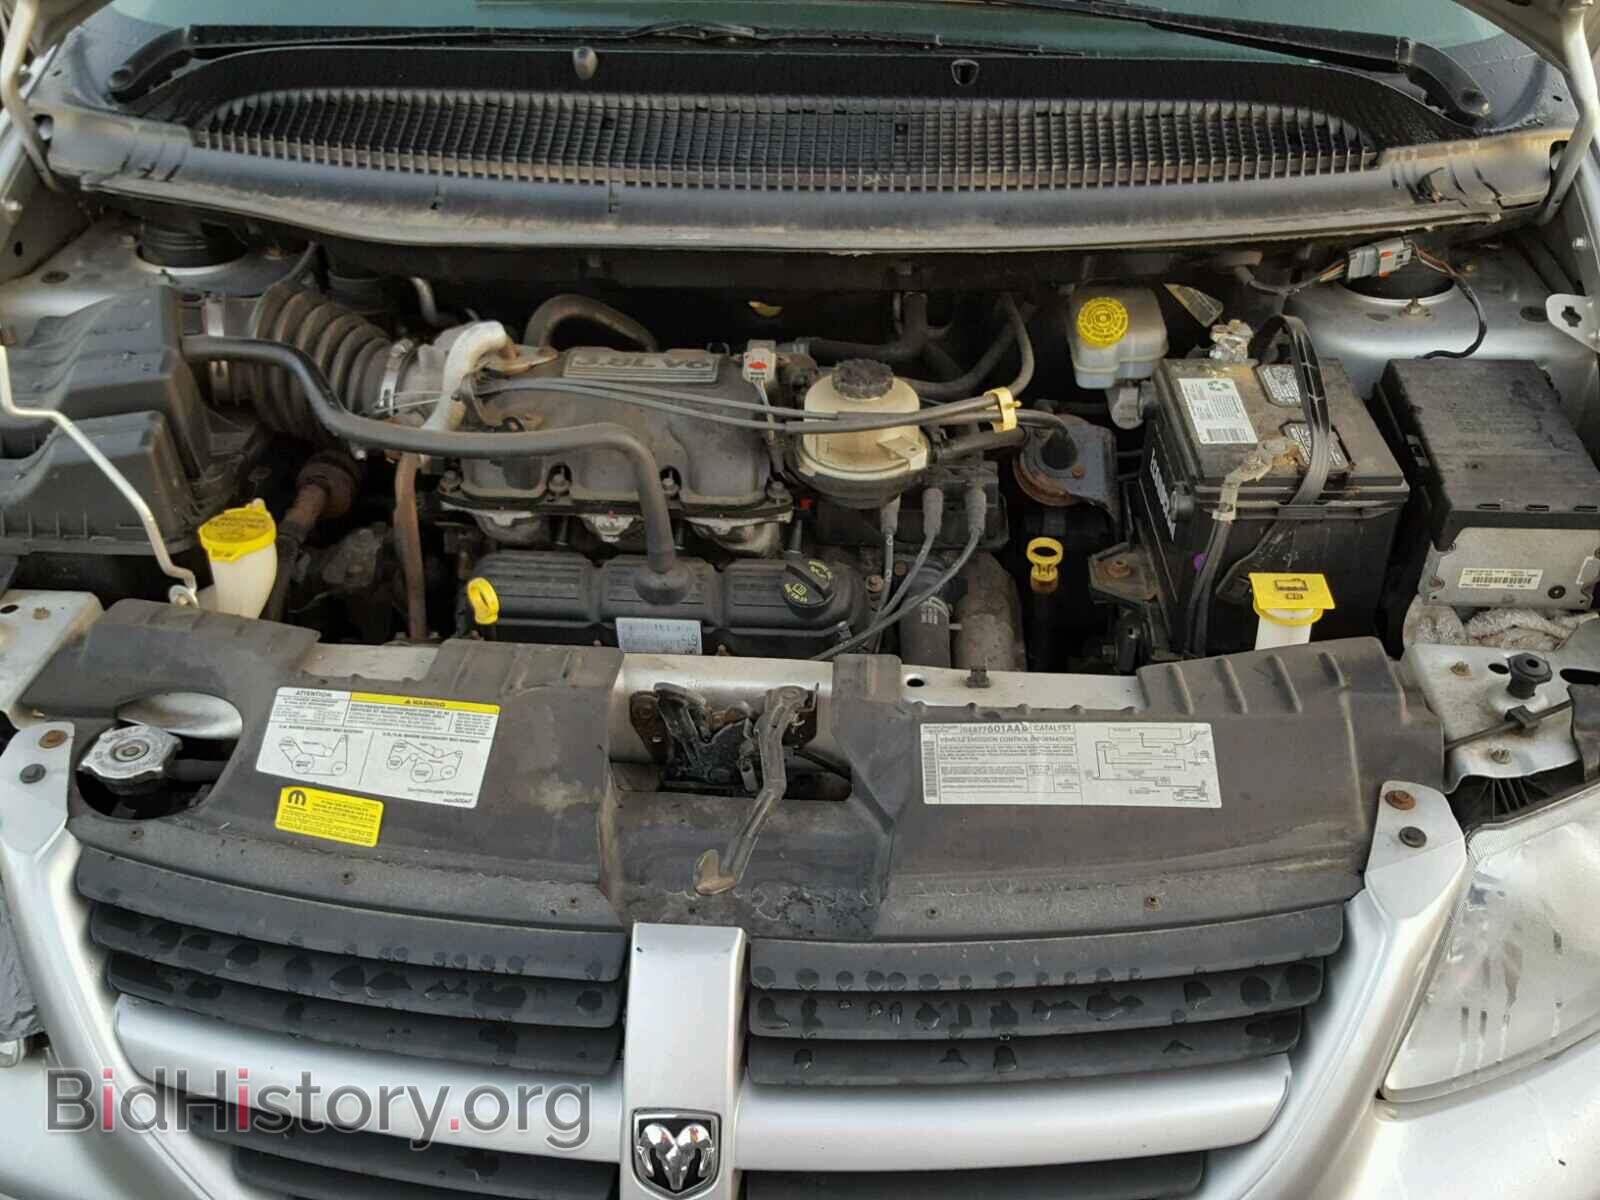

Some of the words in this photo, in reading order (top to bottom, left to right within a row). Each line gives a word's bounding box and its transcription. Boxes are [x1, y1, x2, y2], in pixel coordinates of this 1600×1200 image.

[295, 690, 333, 698] ATTENTION
[412, 697, 446, 708] WARNING
[1033, 724, 1073, 732] CATALYST
[999, 735, 1030, 743] CONTROL
